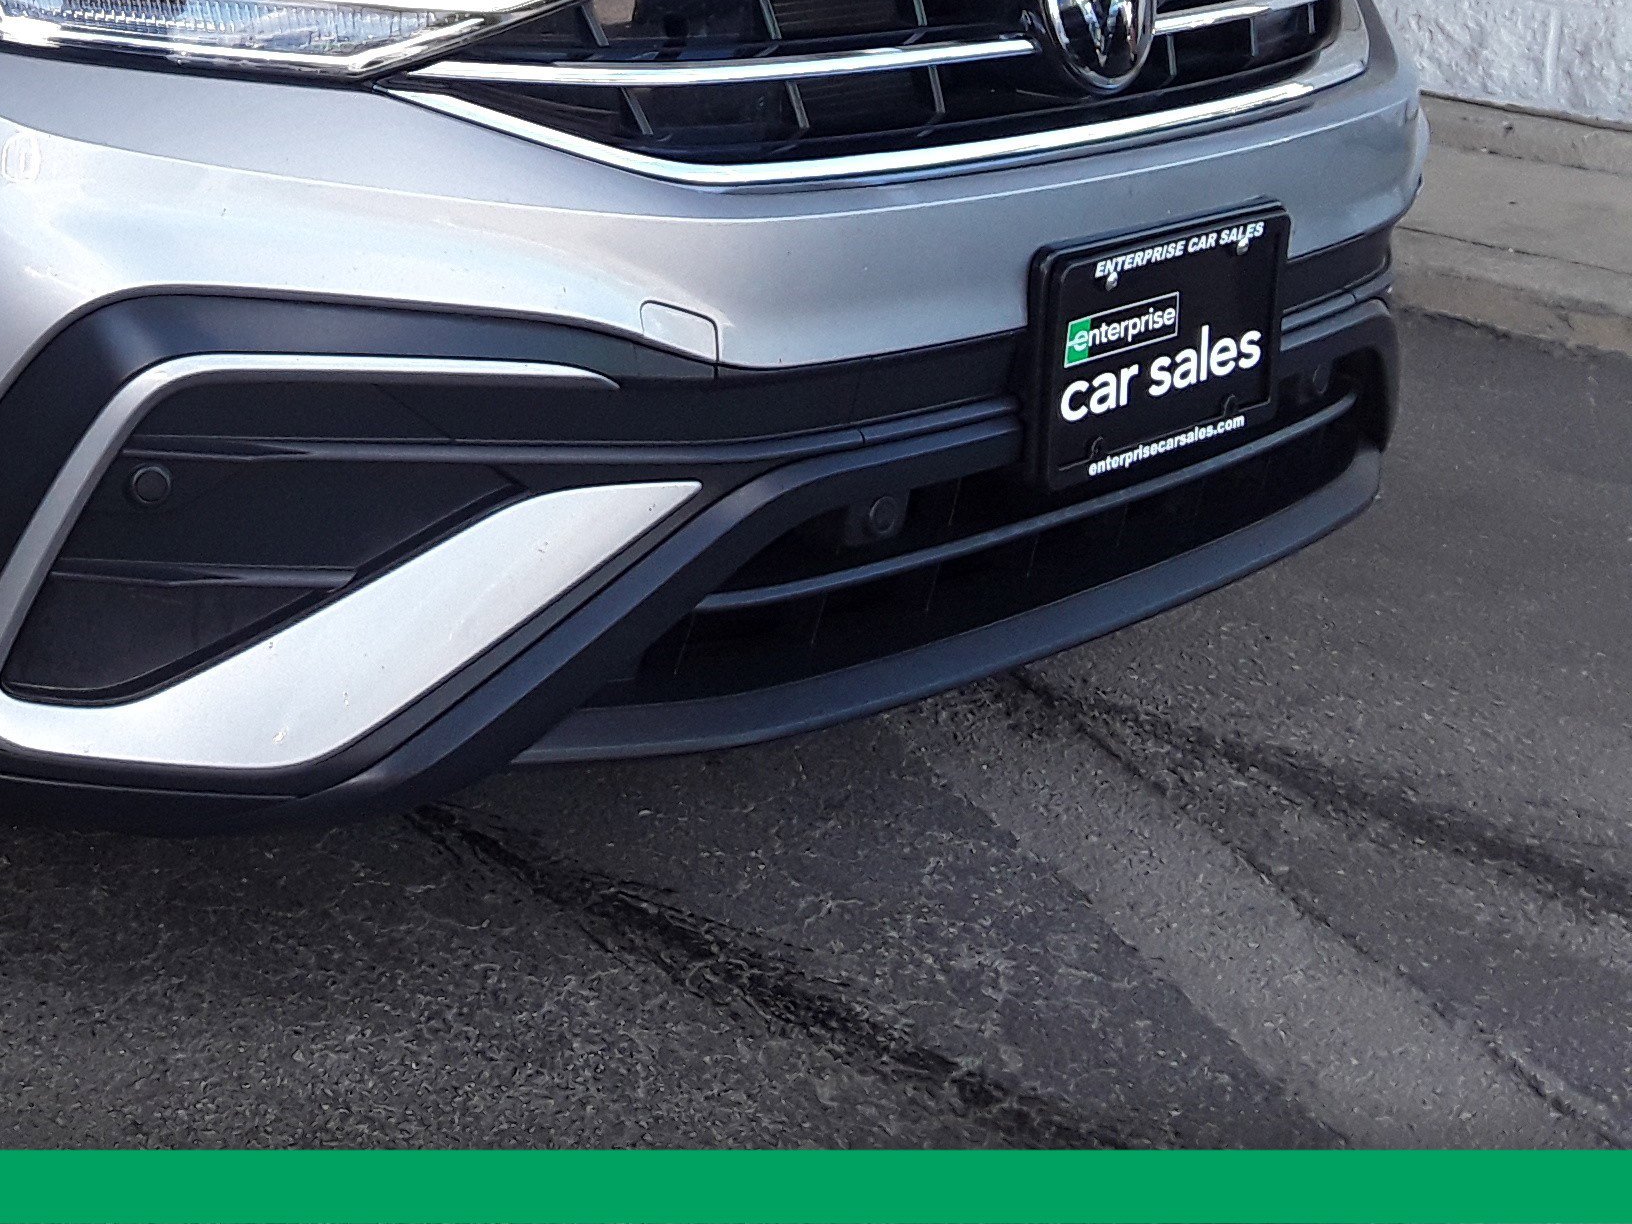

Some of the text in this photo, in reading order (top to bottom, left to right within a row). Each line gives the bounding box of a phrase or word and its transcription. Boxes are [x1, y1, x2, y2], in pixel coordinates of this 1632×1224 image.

[1095, 221, 1265, 278] ENTERPRISE CAR SALES
[1068, 307, 1176, 351] enterprise
[1060, 325, 1262, 422] car sales
[1088, 415, 1245, 476] enterprisecarsales.com
